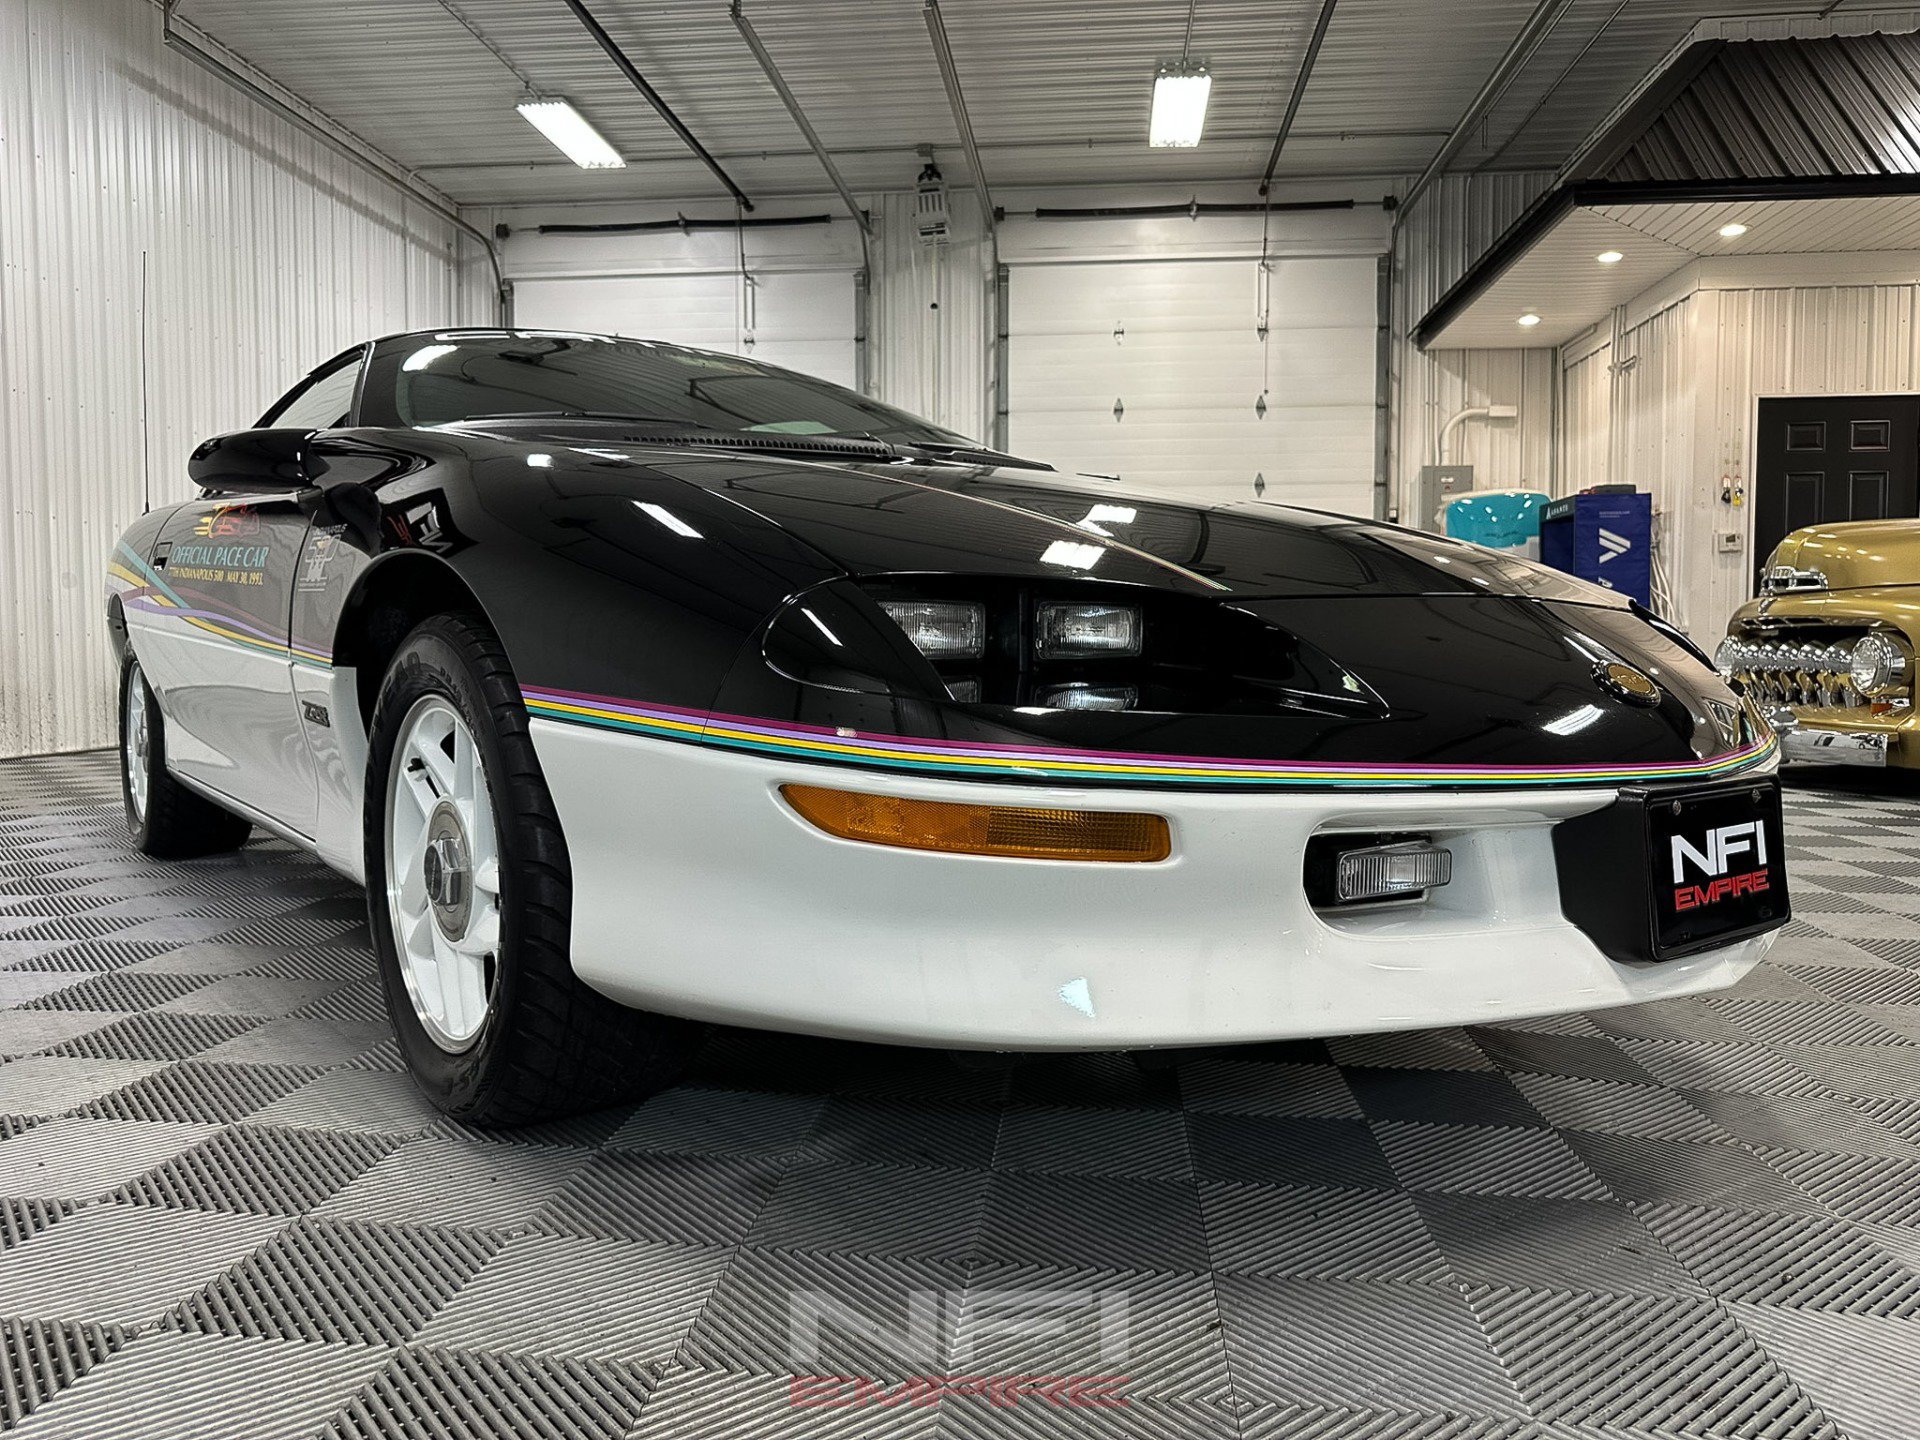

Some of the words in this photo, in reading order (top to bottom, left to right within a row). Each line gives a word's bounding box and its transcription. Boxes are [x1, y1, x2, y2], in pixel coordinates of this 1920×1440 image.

[171, 546, 213, 565] OFFICIAL
[213, 546, 244, 567] PACE
[242, 546, 270, 568] CAR
[180, 567, 214, 582] INDIANAPOLIS
[214, 568, 224, 582] 500
[226, 570, 239, 583] MAY
[1670, 819, 1768, 884] NFI
[1674, 868, 1770, 912] EMPIRE
